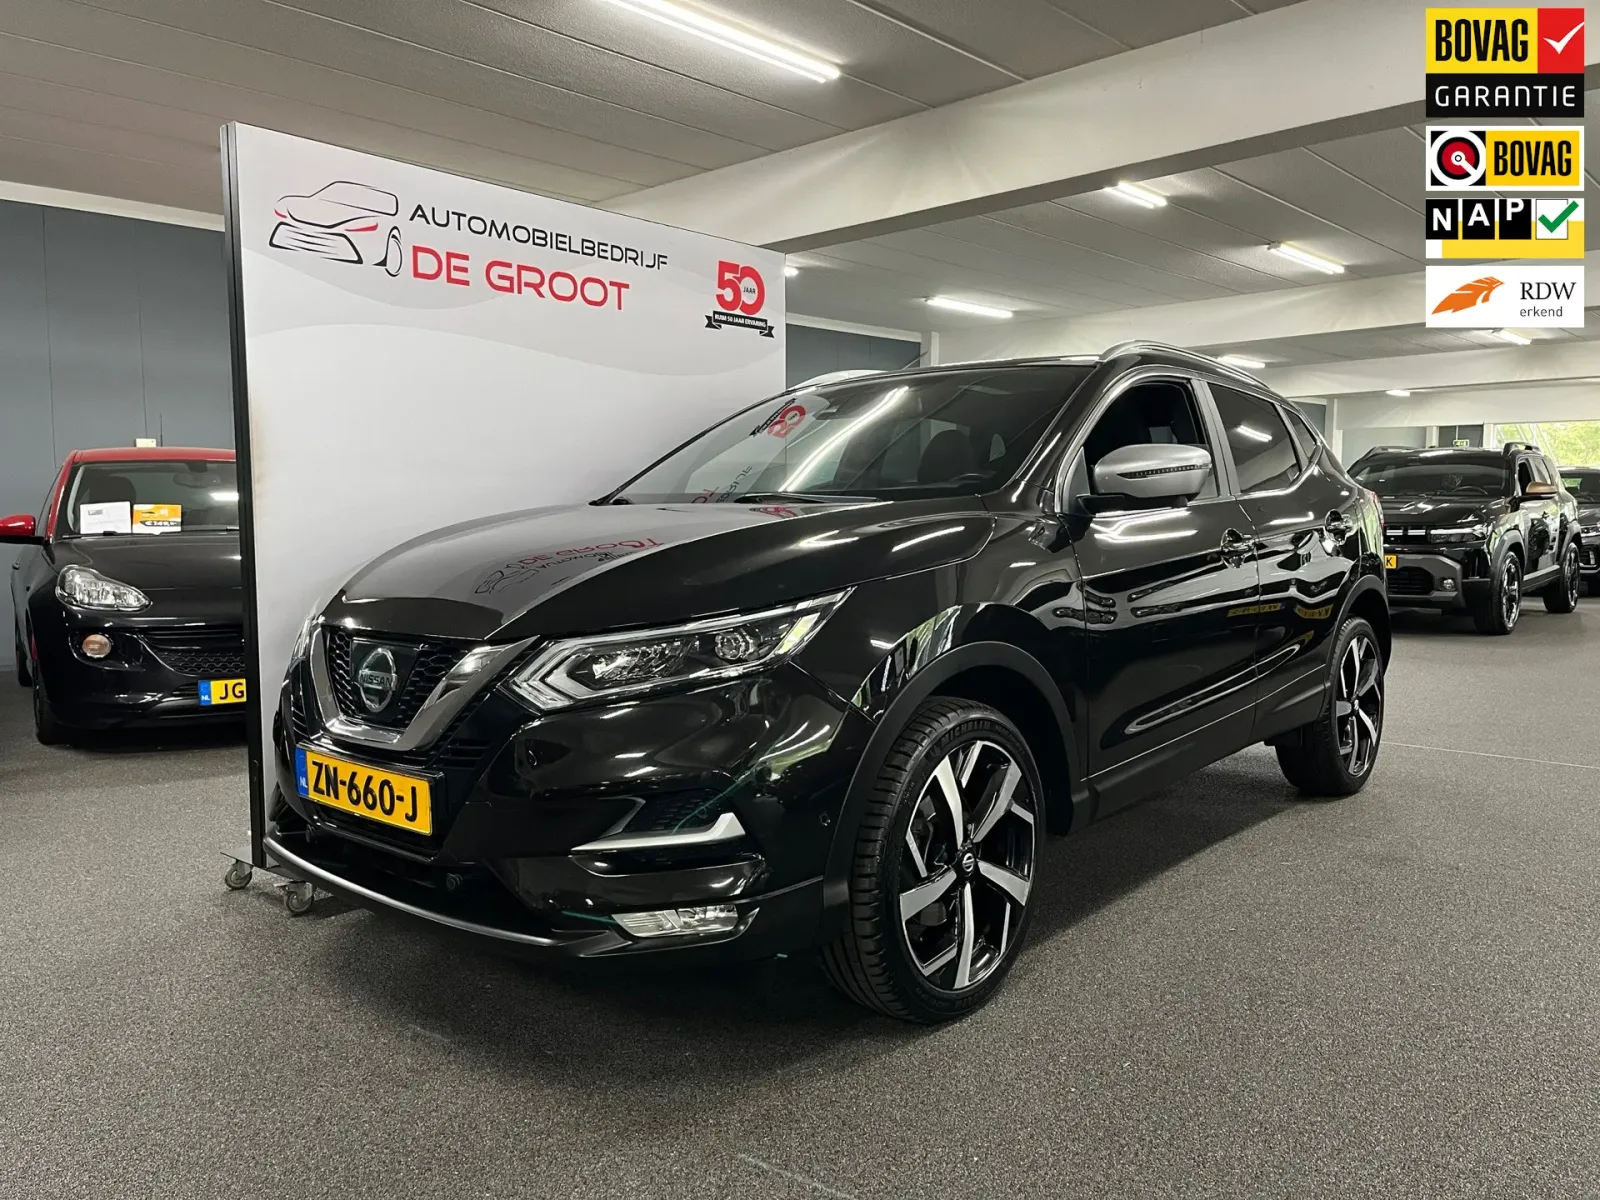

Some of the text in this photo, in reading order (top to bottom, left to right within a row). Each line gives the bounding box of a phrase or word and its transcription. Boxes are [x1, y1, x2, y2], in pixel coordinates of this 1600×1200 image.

[409, 204, 669, 271] AUTOMOBIELBEDRIJF
[413, 245, 631, 311] DE GROOT
[716, 260, 766, 316] 50
[742, 286, 756, 295] JAAR
[219, 681, 245, 700] JG
[359, 671, 392, 690] NISSAN
[299, 760, 418, 822] NL ZN-660-J
